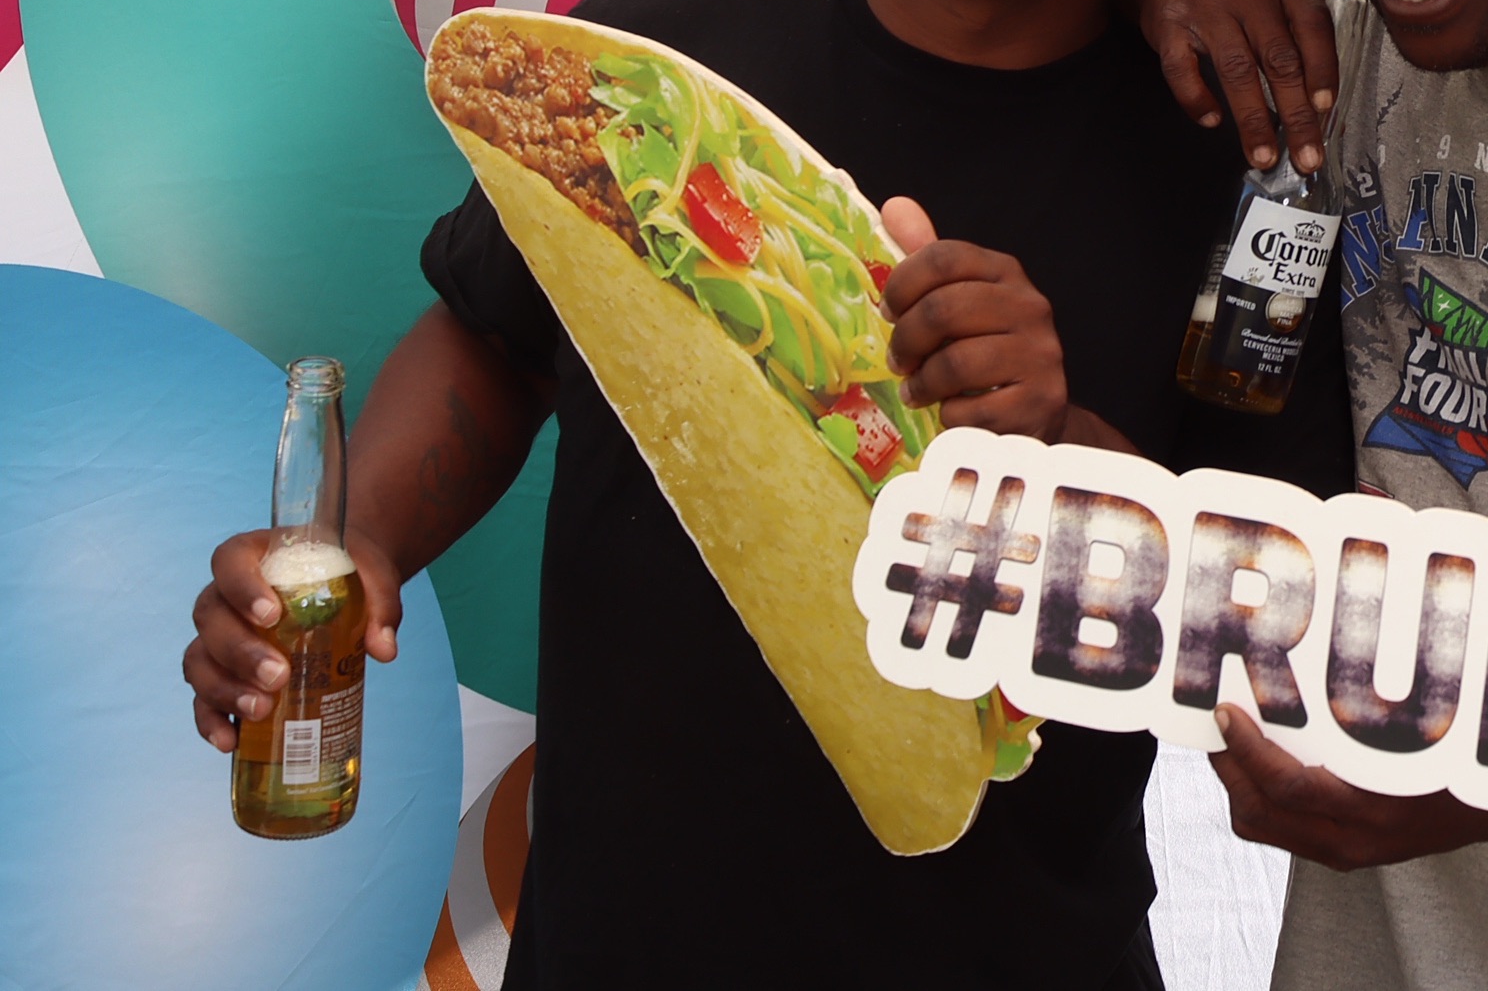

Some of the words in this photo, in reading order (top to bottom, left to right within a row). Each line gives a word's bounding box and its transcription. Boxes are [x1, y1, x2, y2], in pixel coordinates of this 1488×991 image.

[1251, 228, 1331, 268] Coron
[1272, 262, 1317, 288] Extra
[1225, 294, 1257, 311] IMPORTED
[1400, 363, 1488, 433] FOUR
